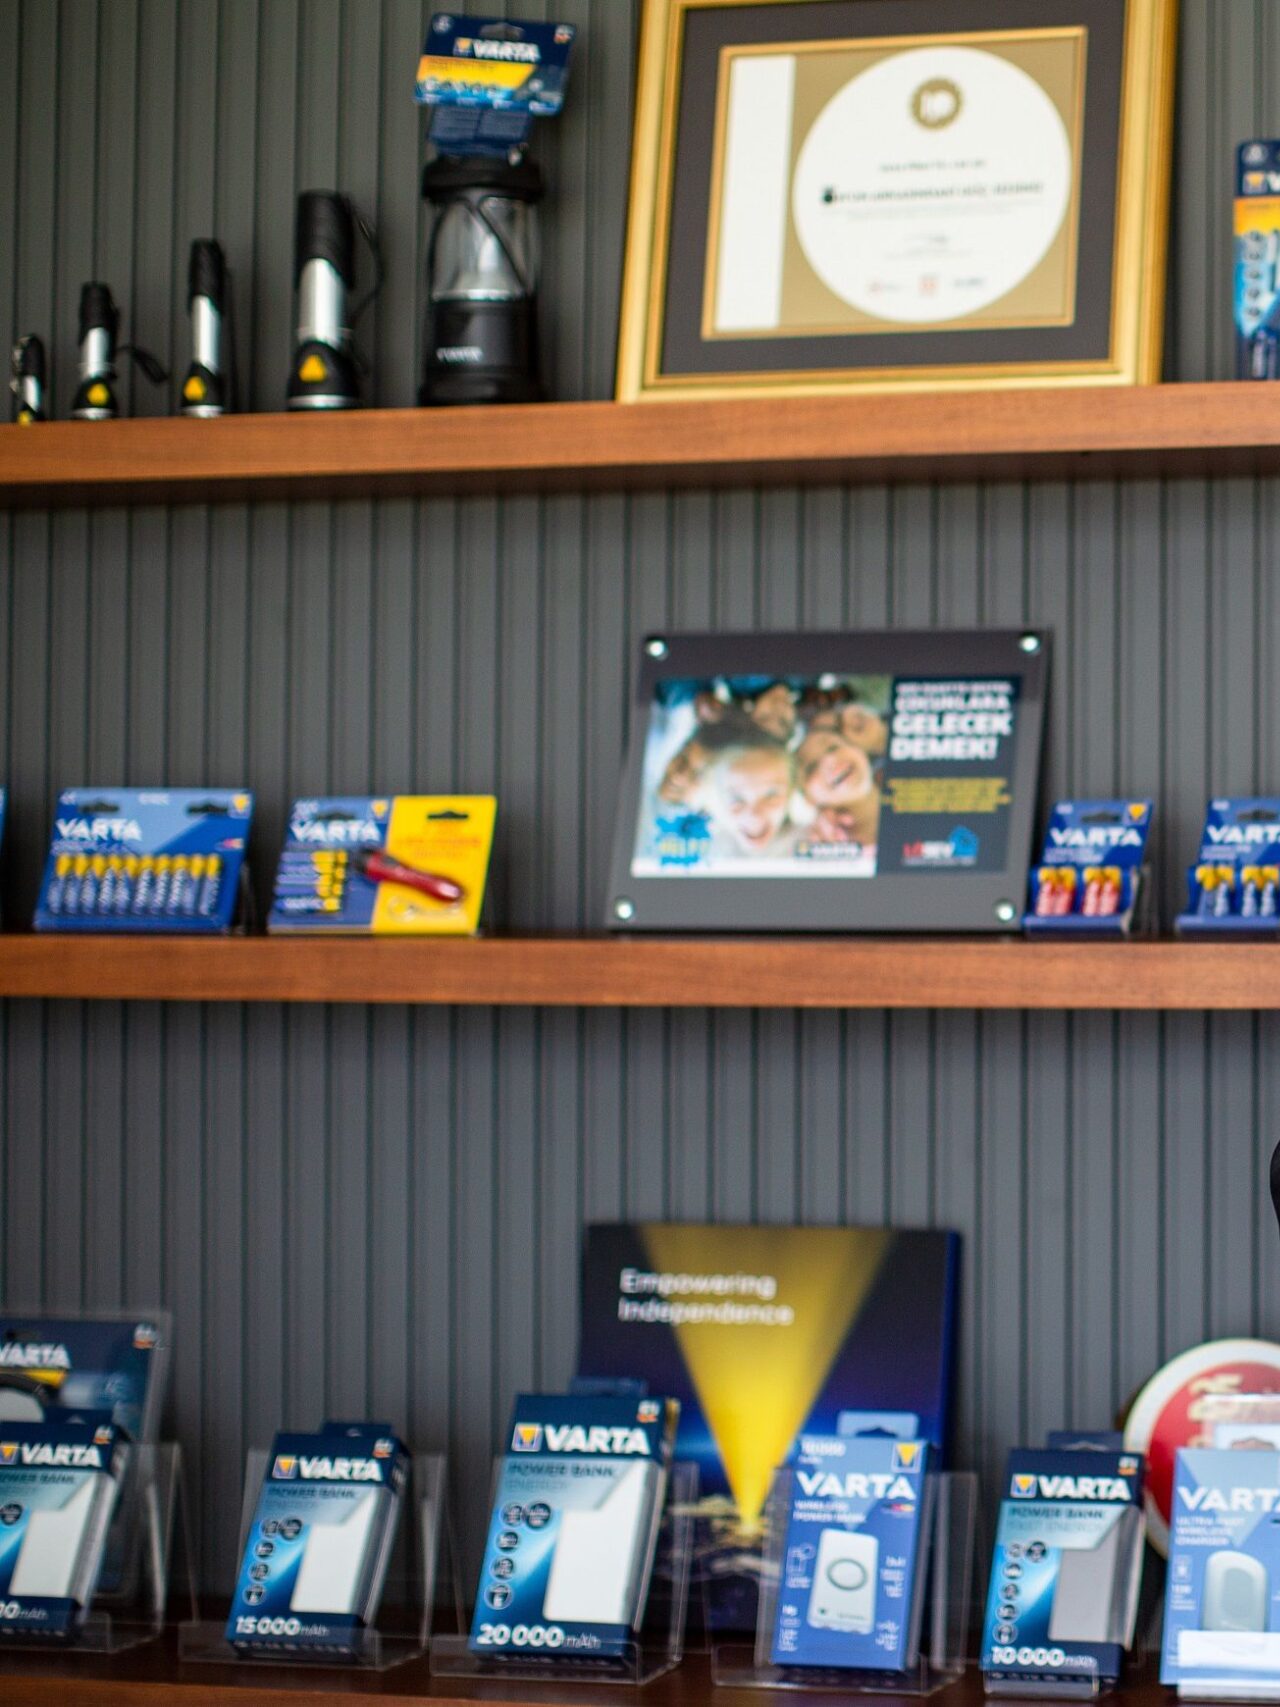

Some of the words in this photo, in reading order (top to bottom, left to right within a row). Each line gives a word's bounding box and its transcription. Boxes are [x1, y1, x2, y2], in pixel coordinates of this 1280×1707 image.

[893, 711, 1013, 736] GELECEK
[890, 735, 999, 760] DEMEK!
[55, 818, 143, 841] VARTA
[290, 819, 381, 842] VARTA
[1050, 827, 1143, 846] VARTA
[619, 1267, 777, 1299] Empowering
[617, 1298, 795, 1326] Independence
[545, 1424, 650, 1455] VARTA
[22, 1442, 103, 1468] VARTA
[299, 1455, 384, 1482] VARTA
[508, 1463, 567, 1476] POWER
[571, 1465, 614, 1477] BANK
[797, 1471, 917, 1501] VARTA
[1038, 1475, 1132, 1501] VARTA
